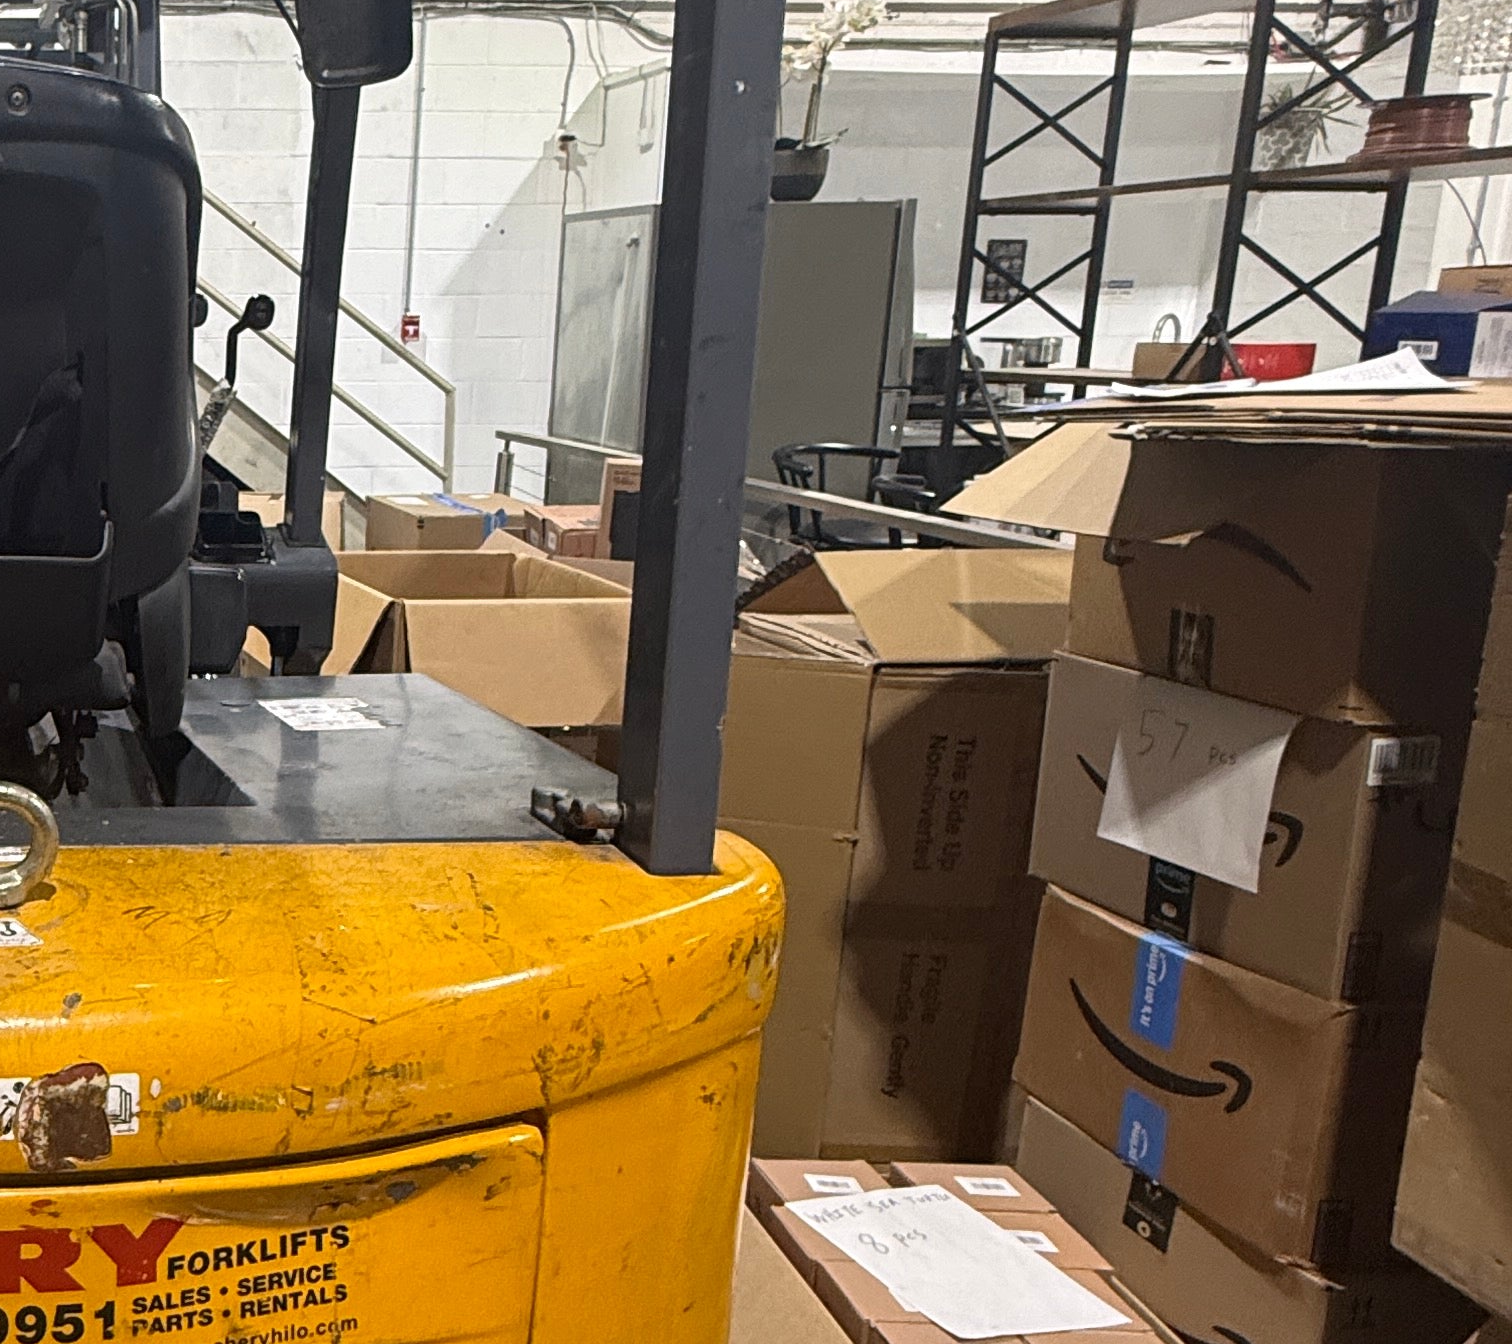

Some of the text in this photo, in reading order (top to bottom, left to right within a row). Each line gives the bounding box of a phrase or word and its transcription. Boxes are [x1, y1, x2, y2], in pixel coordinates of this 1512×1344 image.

[1138, 709, 1190, 763] 57
[1146, 943, 1161, 987] prime
[166, 1225, 350, 1280] FORKLIFTS
[858, 1232, 890, 1255] 8
[132, 1262, 337, 1314] SALES SERVICE
[132, 1284, 348, 1337] PARTS RENTALS
